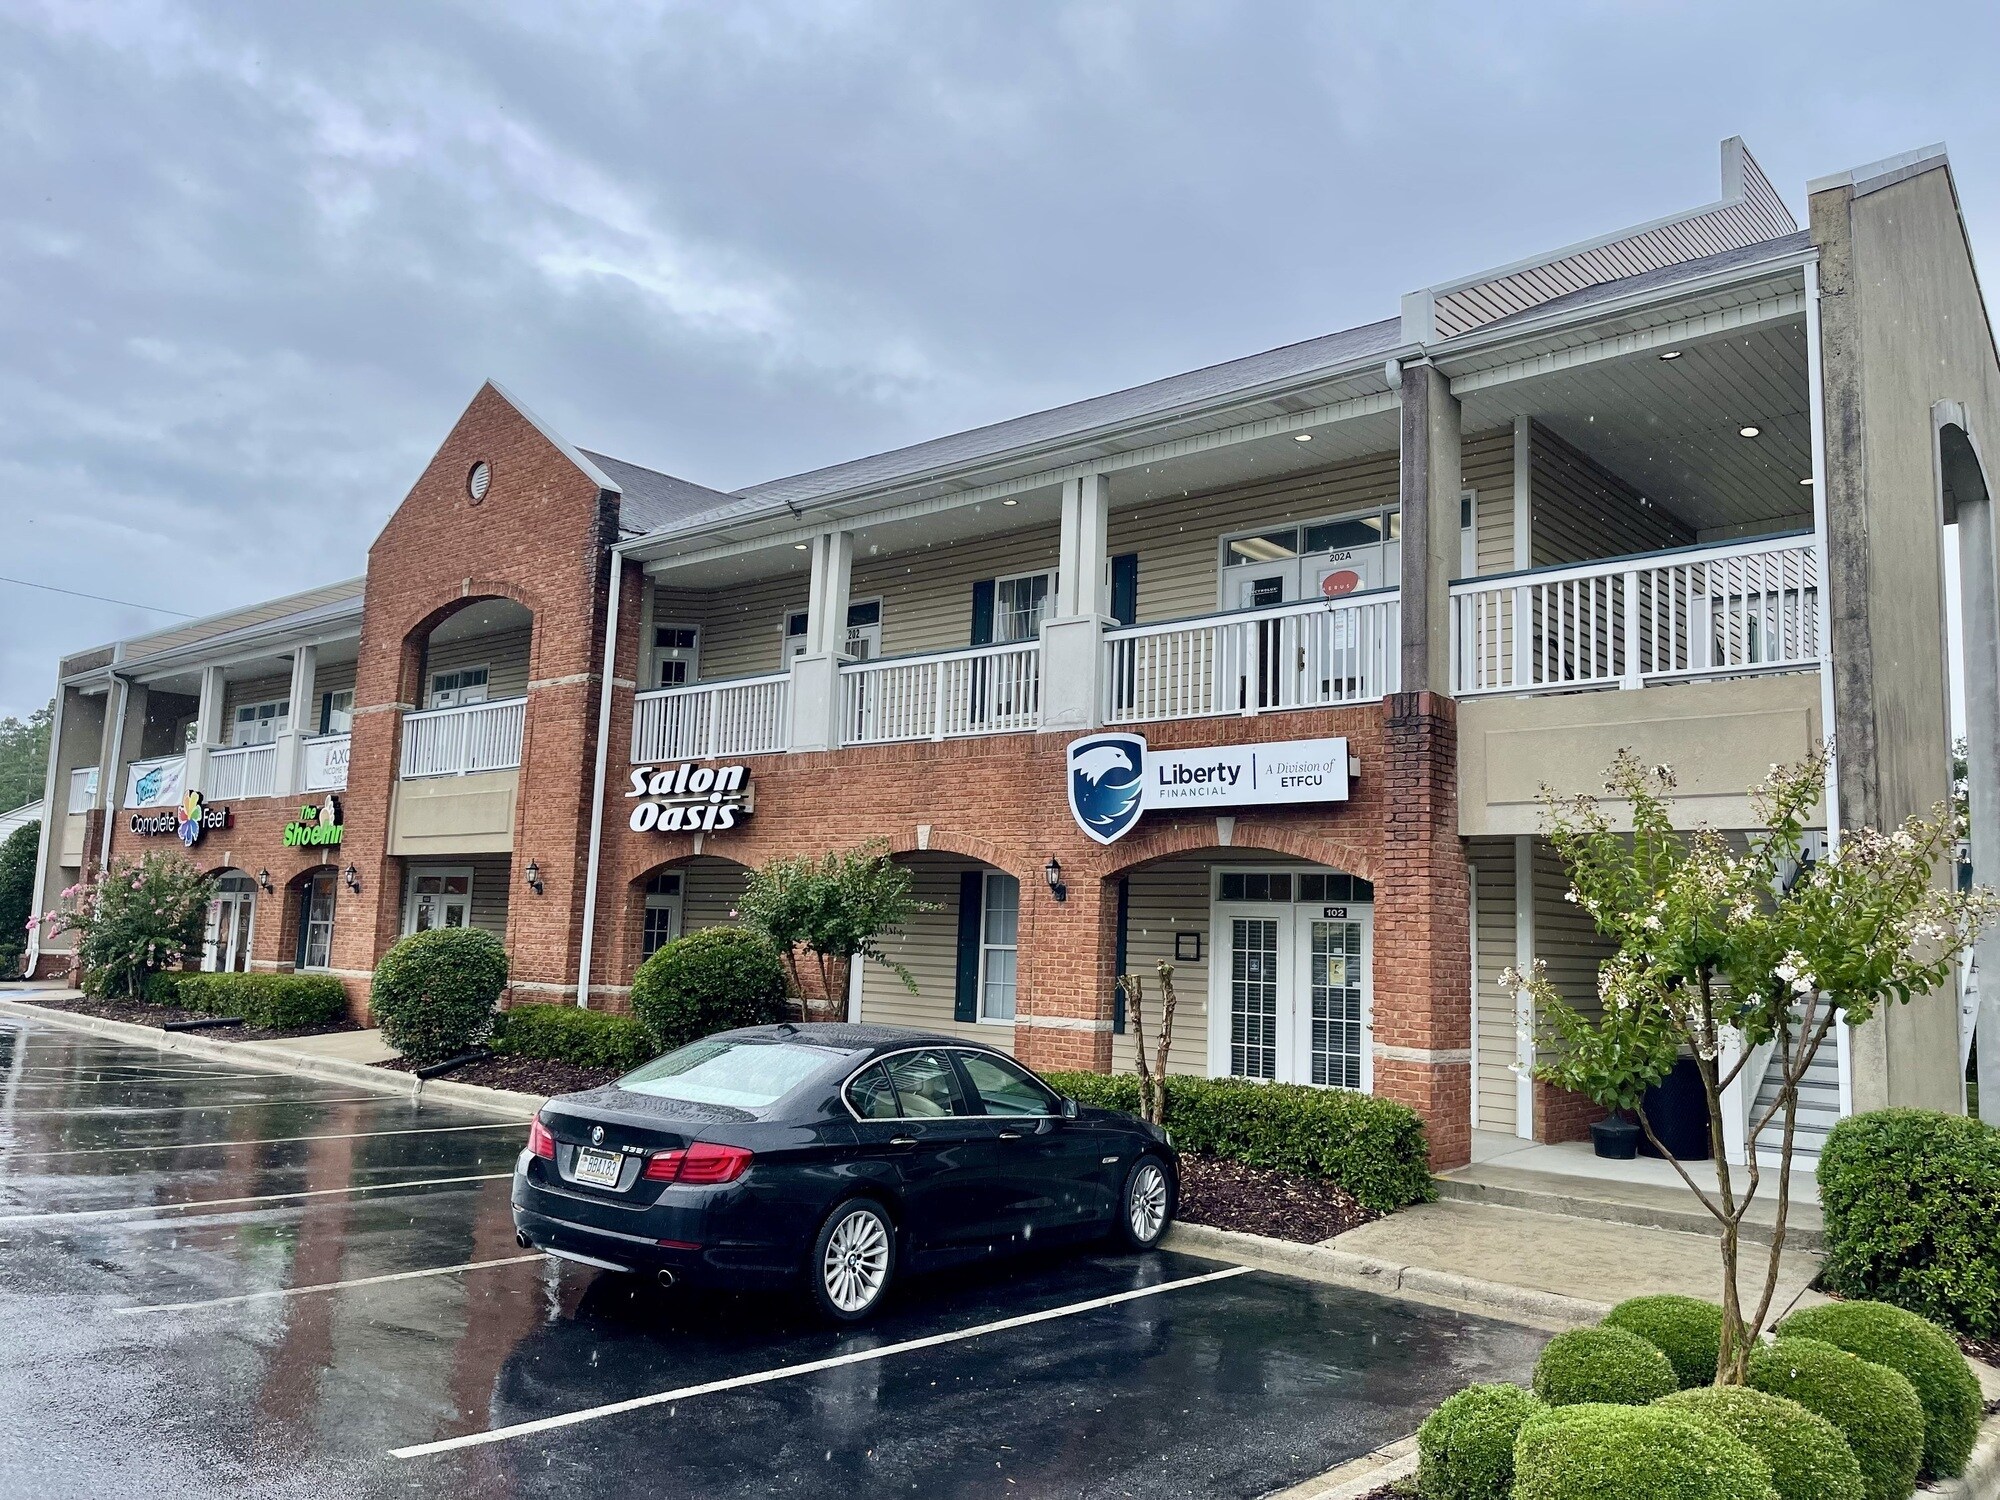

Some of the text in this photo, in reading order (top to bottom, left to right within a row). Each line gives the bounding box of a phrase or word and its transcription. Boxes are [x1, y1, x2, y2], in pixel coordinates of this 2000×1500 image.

[1329, 551, 1352, 562] 202A
[1159, 762, 1242, 786] Liberty
[1265, 758, 1336, 775] A Division of
[624, 763, 744, 798] Salon
[1281, 774, 1323, 788] ETFCU
[1160, 786, 1227, 798] FINANCIAL
[300, 804, 317, 820] The
[629, 792, 740, 833] Oasis
[130, 807, 227, 837] Complete Feet
[1326, 909, 1345, 918] 102
